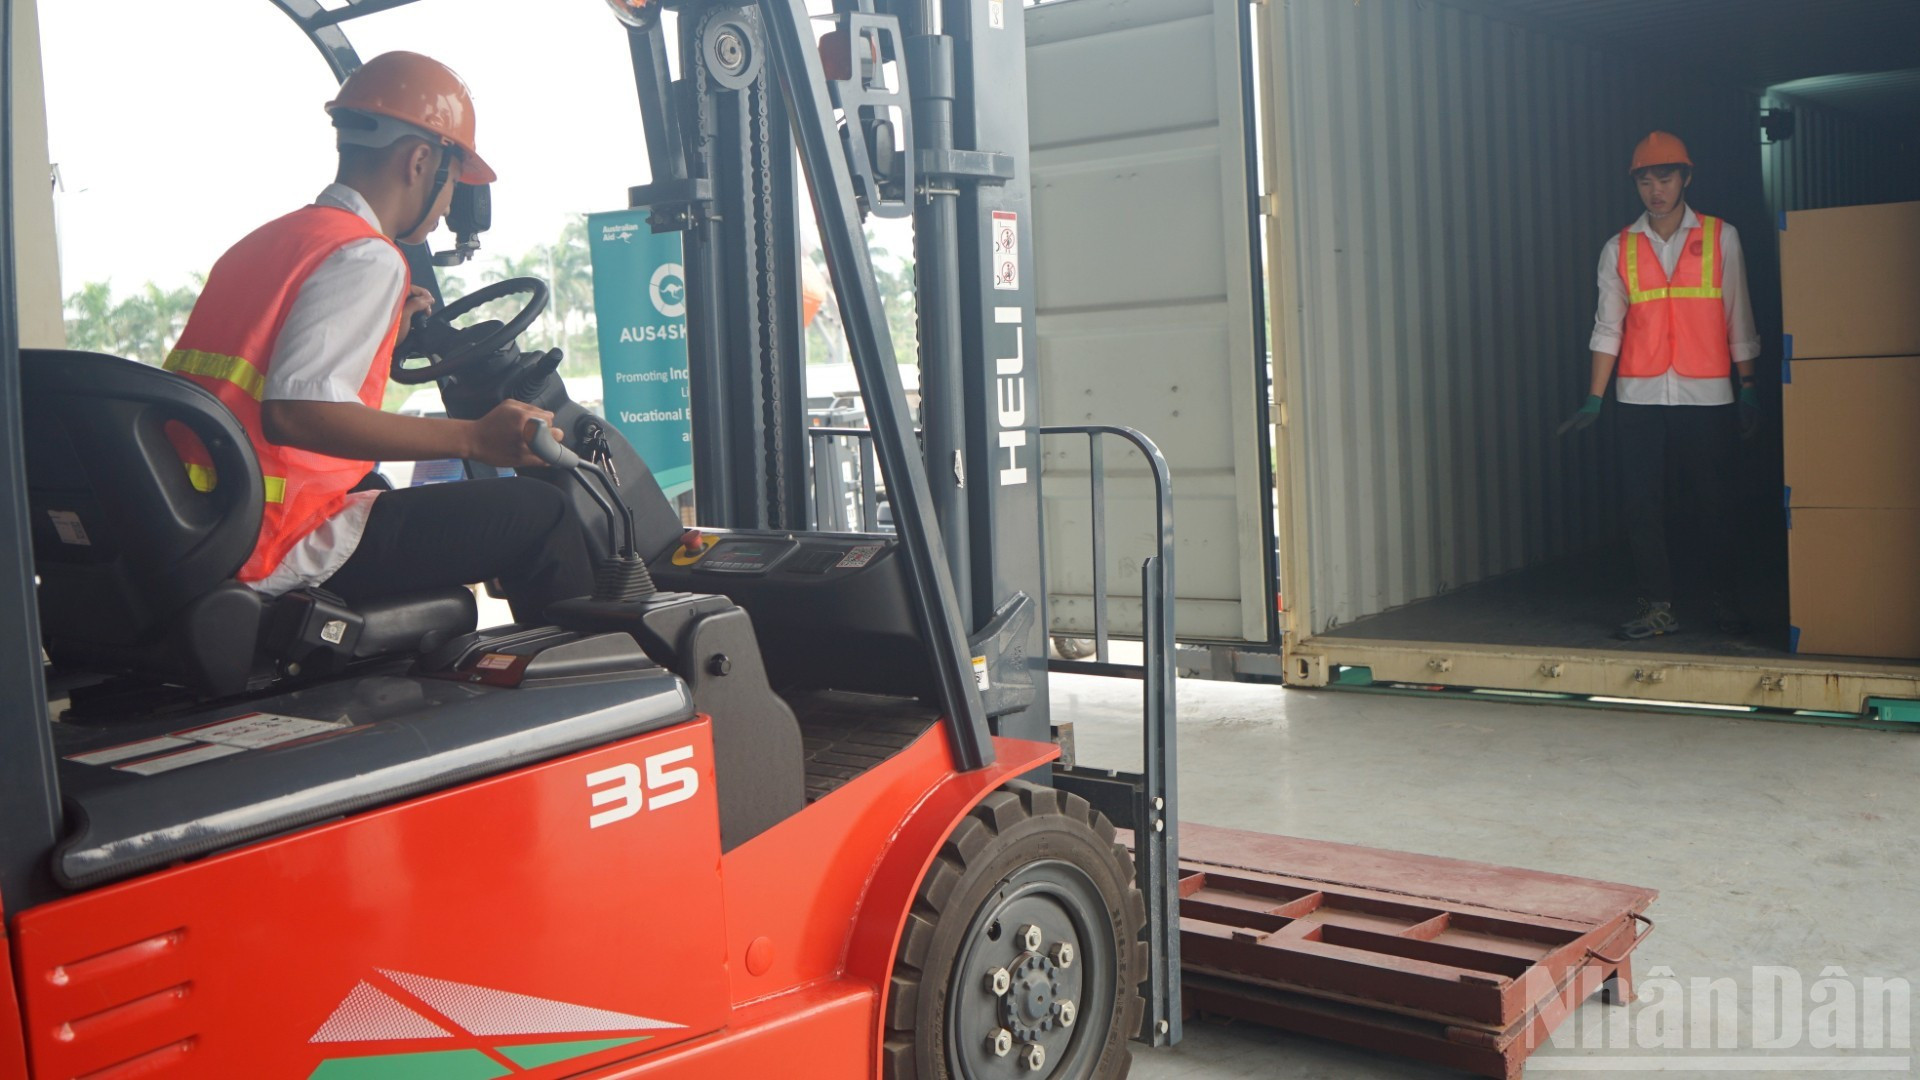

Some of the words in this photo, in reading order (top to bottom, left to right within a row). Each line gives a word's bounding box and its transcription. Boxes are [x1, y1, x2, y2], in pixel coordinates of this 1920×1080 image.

[603, 224, 638, 234] Australian
[603, 233, 616, 241] Aid
[616, 370, 668, 383] Promoting
[995, 307, 1027, 486] HELI
[620, 408, 682, 423] Vocational
[586, 745, 699, 829] 35
